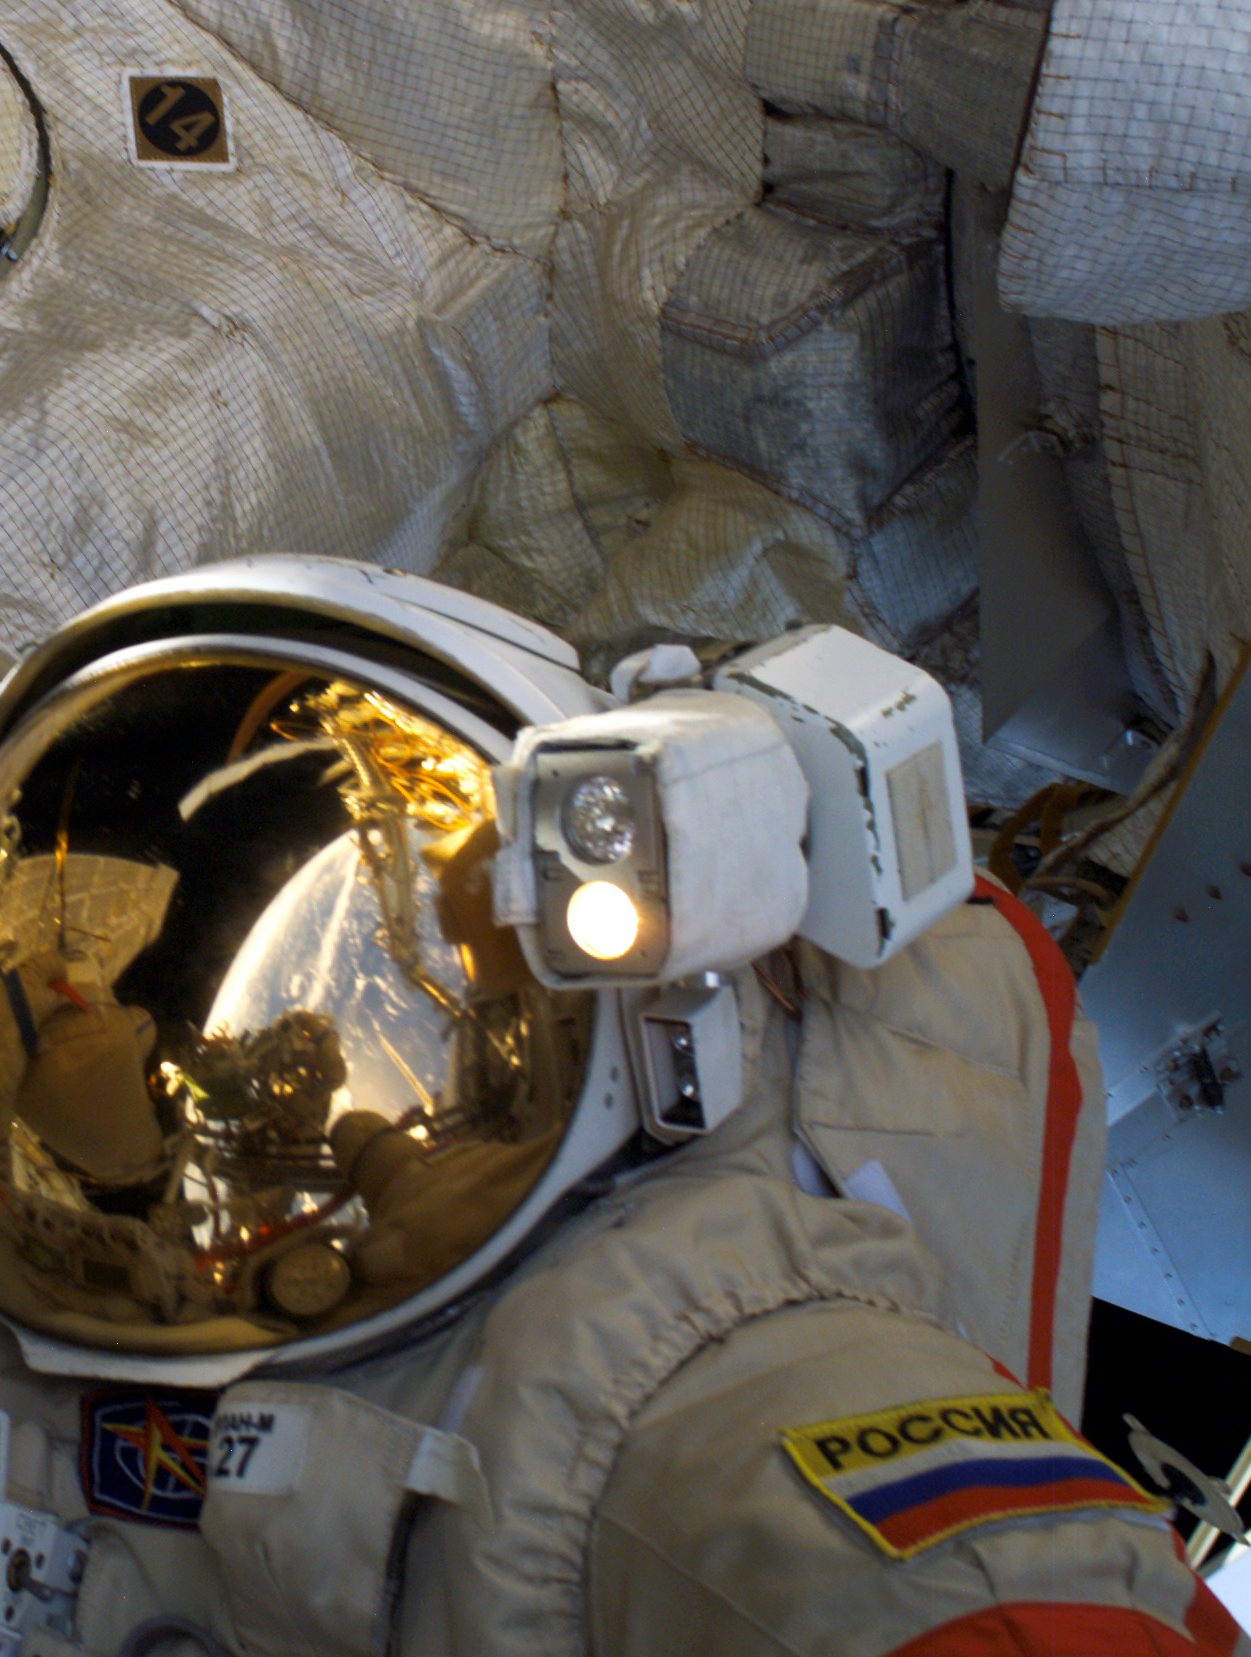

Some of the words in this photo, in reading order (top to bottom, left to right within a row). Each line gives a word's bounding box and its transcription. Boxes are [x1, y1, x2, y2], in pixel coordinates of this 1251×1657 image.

[144, 84, 218, 151] 14
[216, 1435, 260, 1478] 27
[815, 1406, 1053, 1471] РОССИЯ
